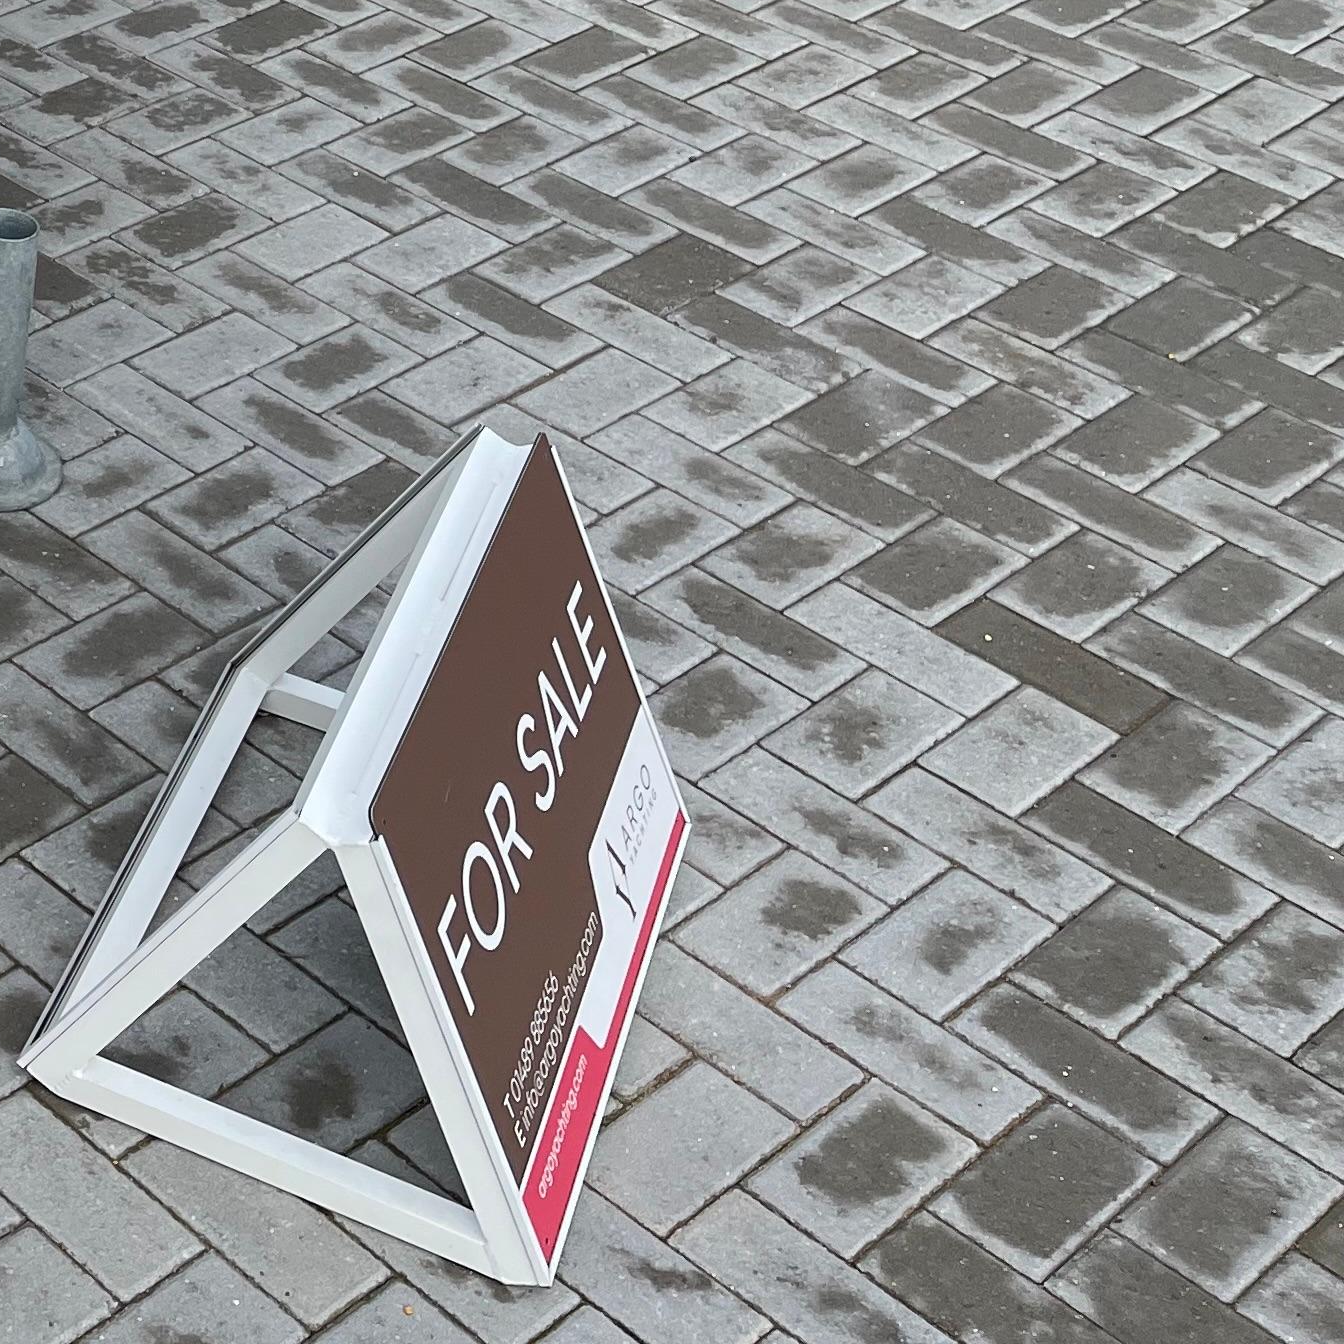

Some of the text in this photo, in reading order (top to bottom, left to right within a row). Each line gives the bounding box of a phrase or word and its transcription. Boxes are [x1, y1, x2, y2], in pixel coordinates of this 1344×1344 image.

[436, 580, 609, 1017] FOR SALE
[620, 764, 652, 852] ARGO
[629, 788, 658, 866] YACHTING
[502, 1092, 516, 1120] T
[509, 1038, 534, 1094] 01489
[513, 910, 599, 1150] E info@argoyachting.com
[537, 1053, 589, 1200] argoyachting.com
